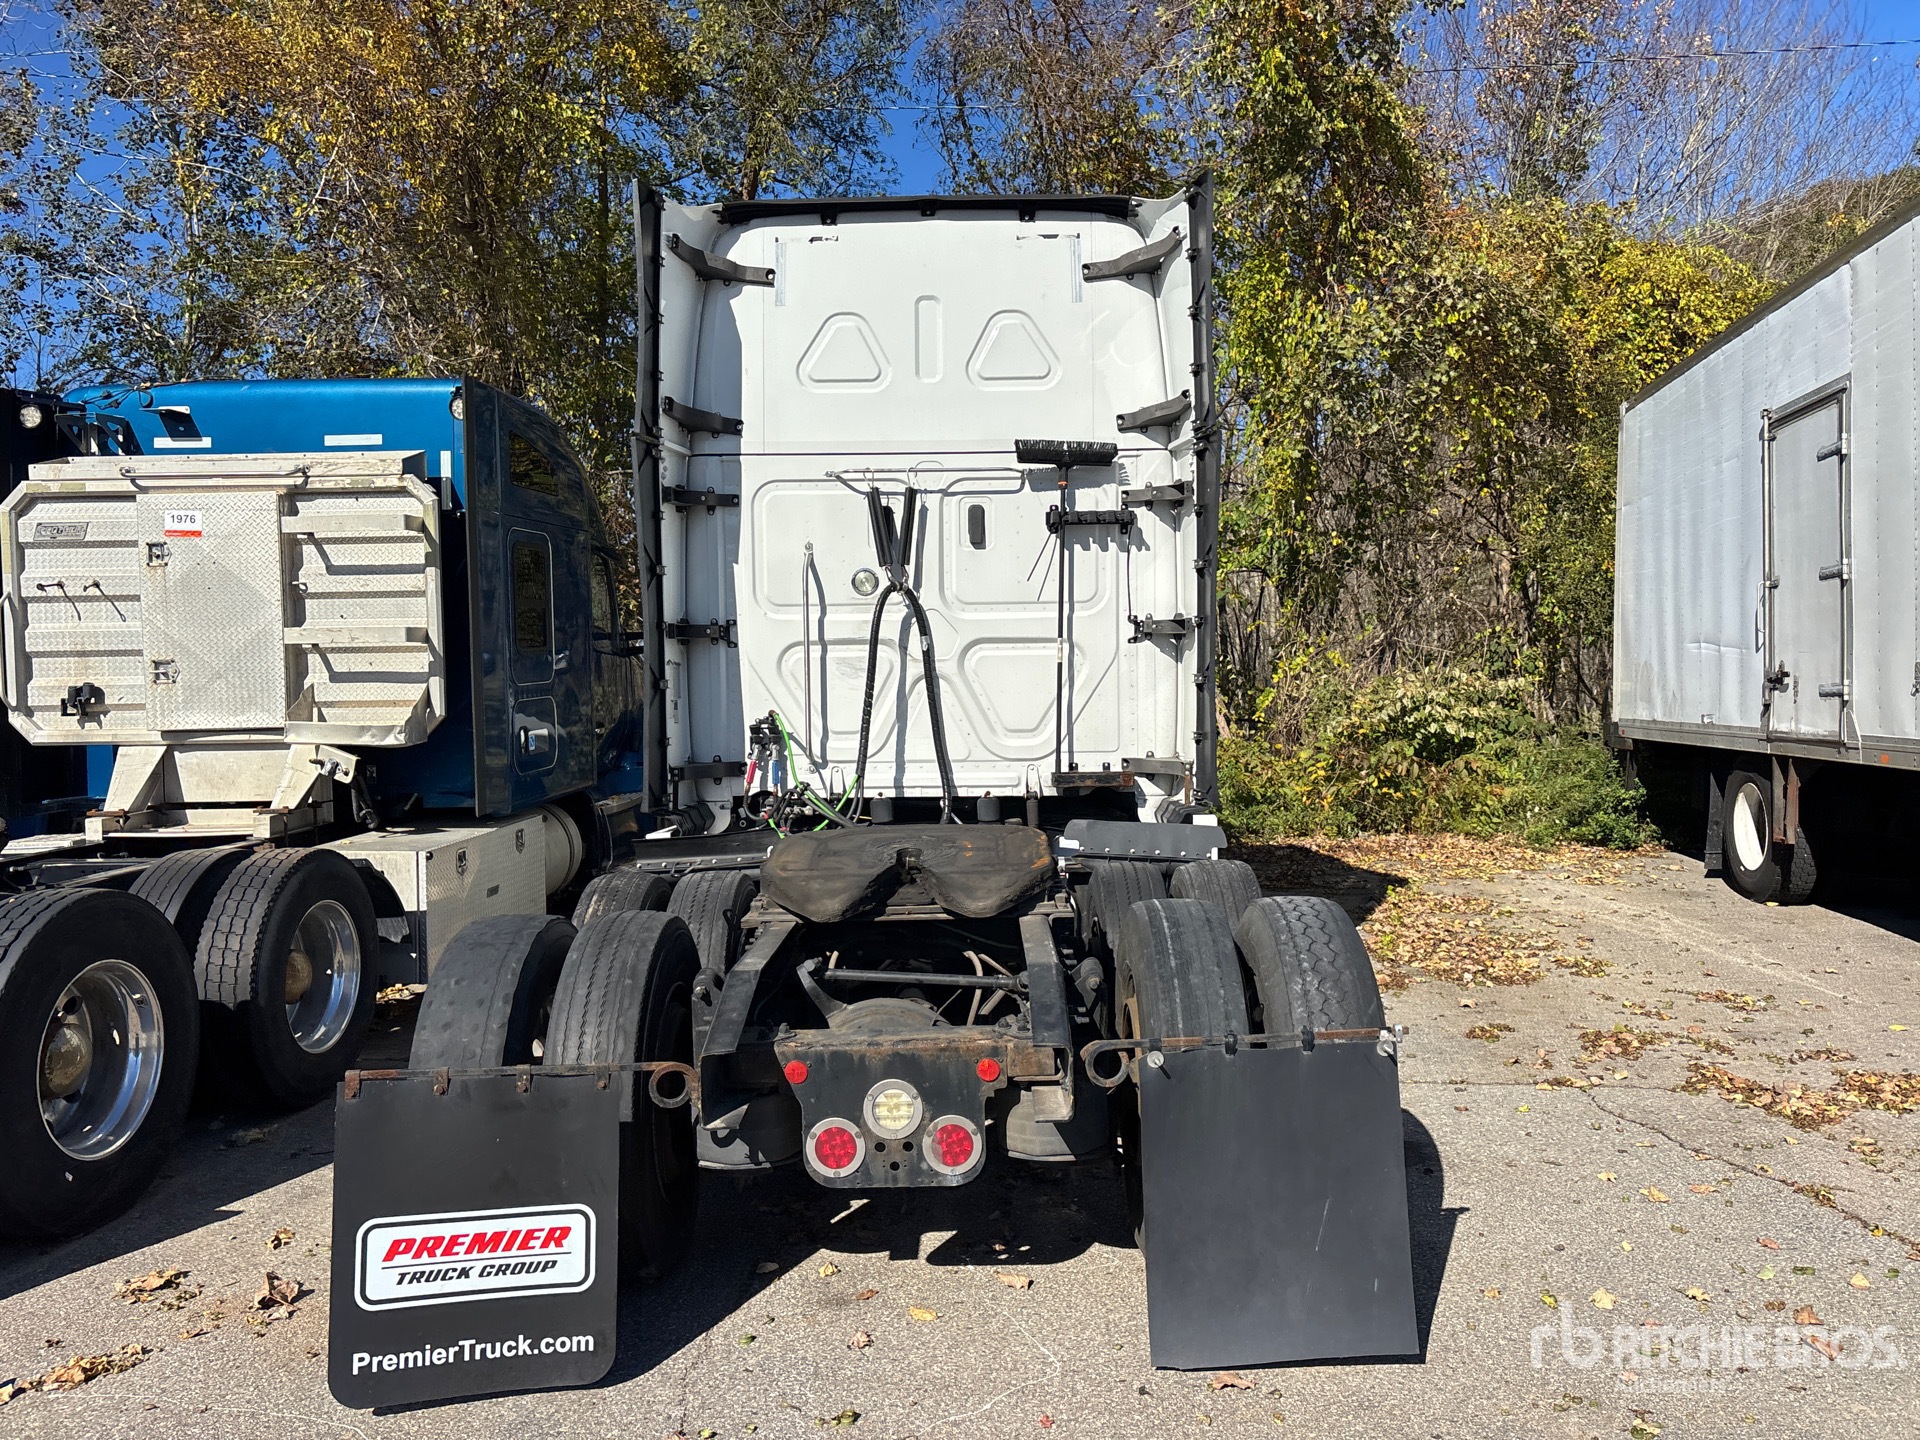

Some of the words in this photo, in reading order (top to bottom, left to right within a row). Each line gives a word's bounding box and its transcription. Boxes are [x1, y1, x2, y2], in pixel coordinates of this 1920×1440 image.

[170, 514, 196, 524] 1976
[382, 1226, 572, 1262] PREMIER
[396, 1265, 475, 1286] TRUCK
[478, 1259, 558, 1279] GROUP
[352, 1334, 594, 1376] PremierTruck.com
